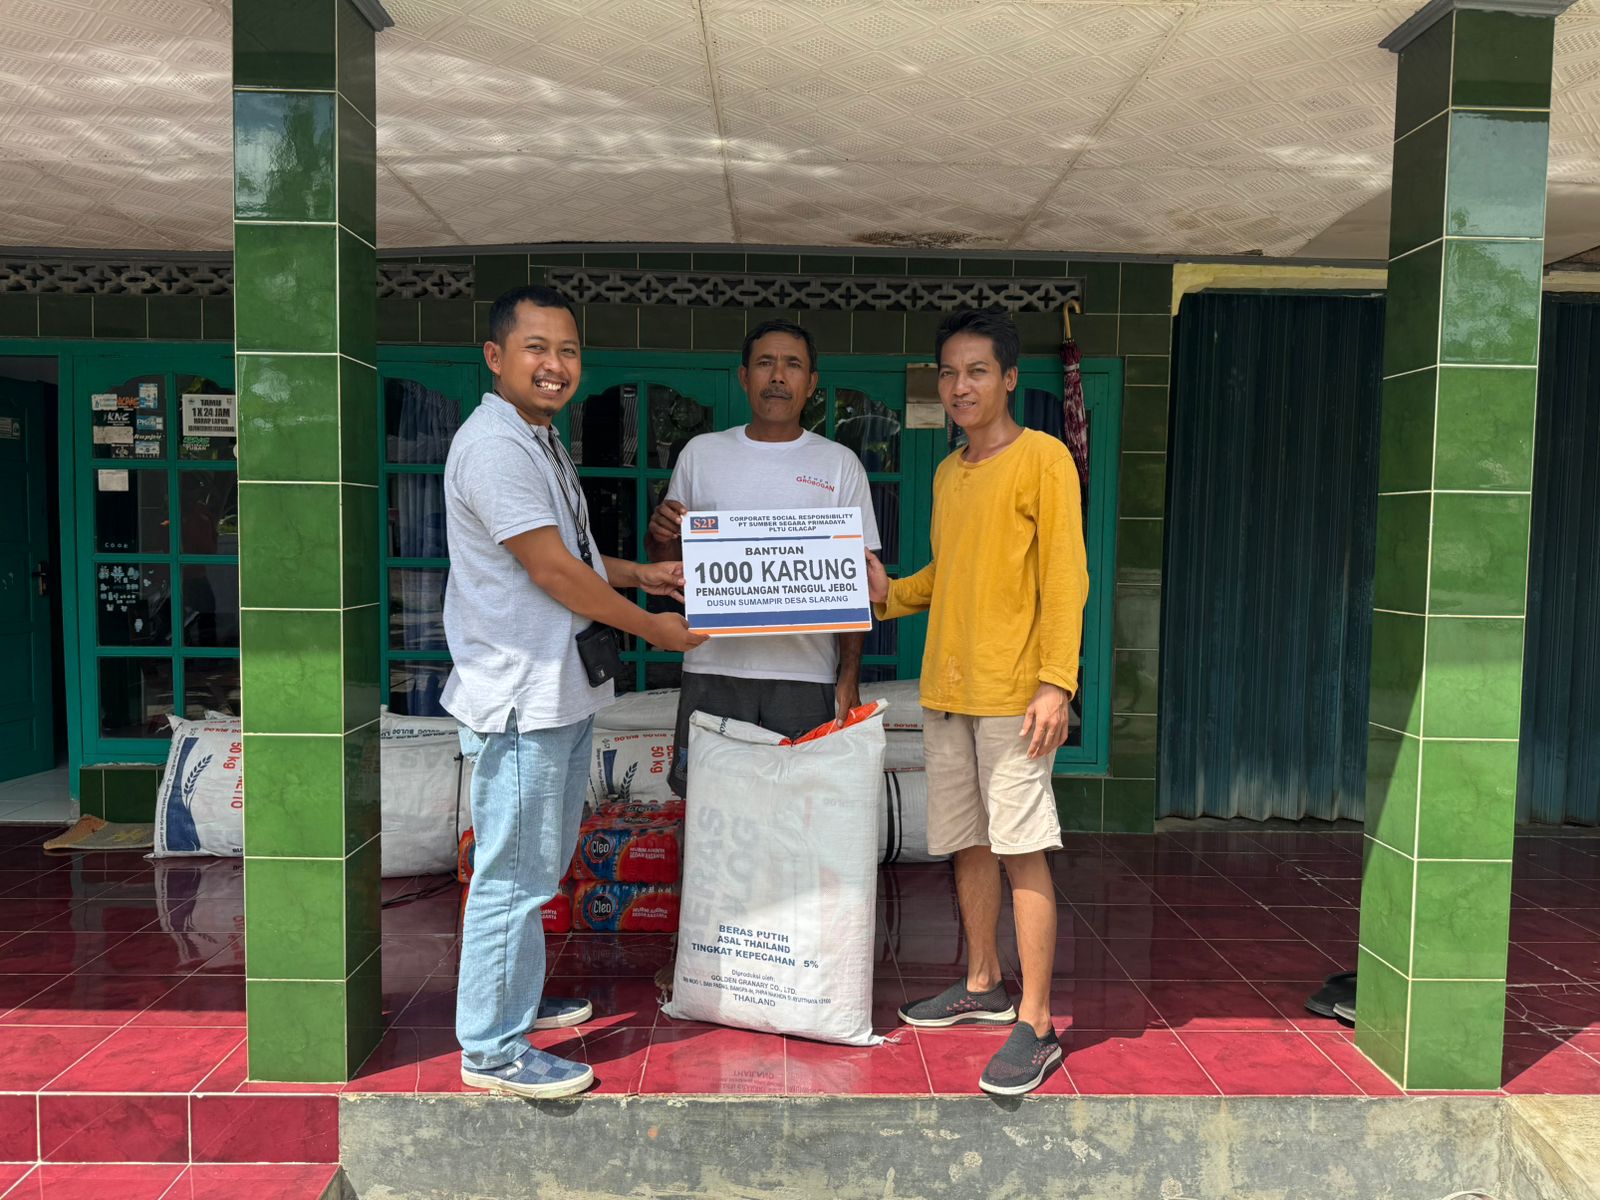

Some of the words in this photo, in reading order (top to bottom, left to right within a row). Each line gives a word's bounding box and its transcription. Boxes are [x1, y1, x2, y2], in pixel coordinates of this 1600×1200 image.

[192, 408, 197, 416] 1
[204, 408, 213, 416] 24
[214, 408, 230, 418] JAM
[796, 476, 835, 492] GROBOGAN
[693, 518, 716, 529] S2P
[745, 546, 804, 556] BANTUAN
[694, 561, 754, 584] 1000
[761, 558, 857, 583] KARUNG
[696, 586, 780, 597] PENANGULANGAN
[782, 584, 826, 595] TANGGUL
[828, 583, 858, 593] JEBOL
[706, 599, 737, 607] DUSUN
[738, 598, 782, 606] SUMAMPIR
[784, 596, 808, 604] DESA
[808, 596, 848, 604] SLARANG
[230, 742, 243, 753] 50
[651, 746, 664, 758] 50
[223, 756, 241, 770] kg
[650, 760, 665, 774] kg
[592, 840, 610, 854] Cleo
[593, 899, 612, 914] Cleo
[719, 924, 754, 938] BERAS
[756, 930, 789, 943] PUTIH
[717, 936, 742, 946] ASAL
[744, 939, 791, 954] THAILAND
[692, 942, 732, 956] TINGKAT
[735, 950, 796, 967] KEPECAHAN
[803, 960, 820, 969] 5%
[732, 969, 761, 980] Diproduksi
[710, 974, 738, 985] GOLDEN
[738, 978, 770, 990] GRANARY
[733, 993, 776, 1007] THAILAND
